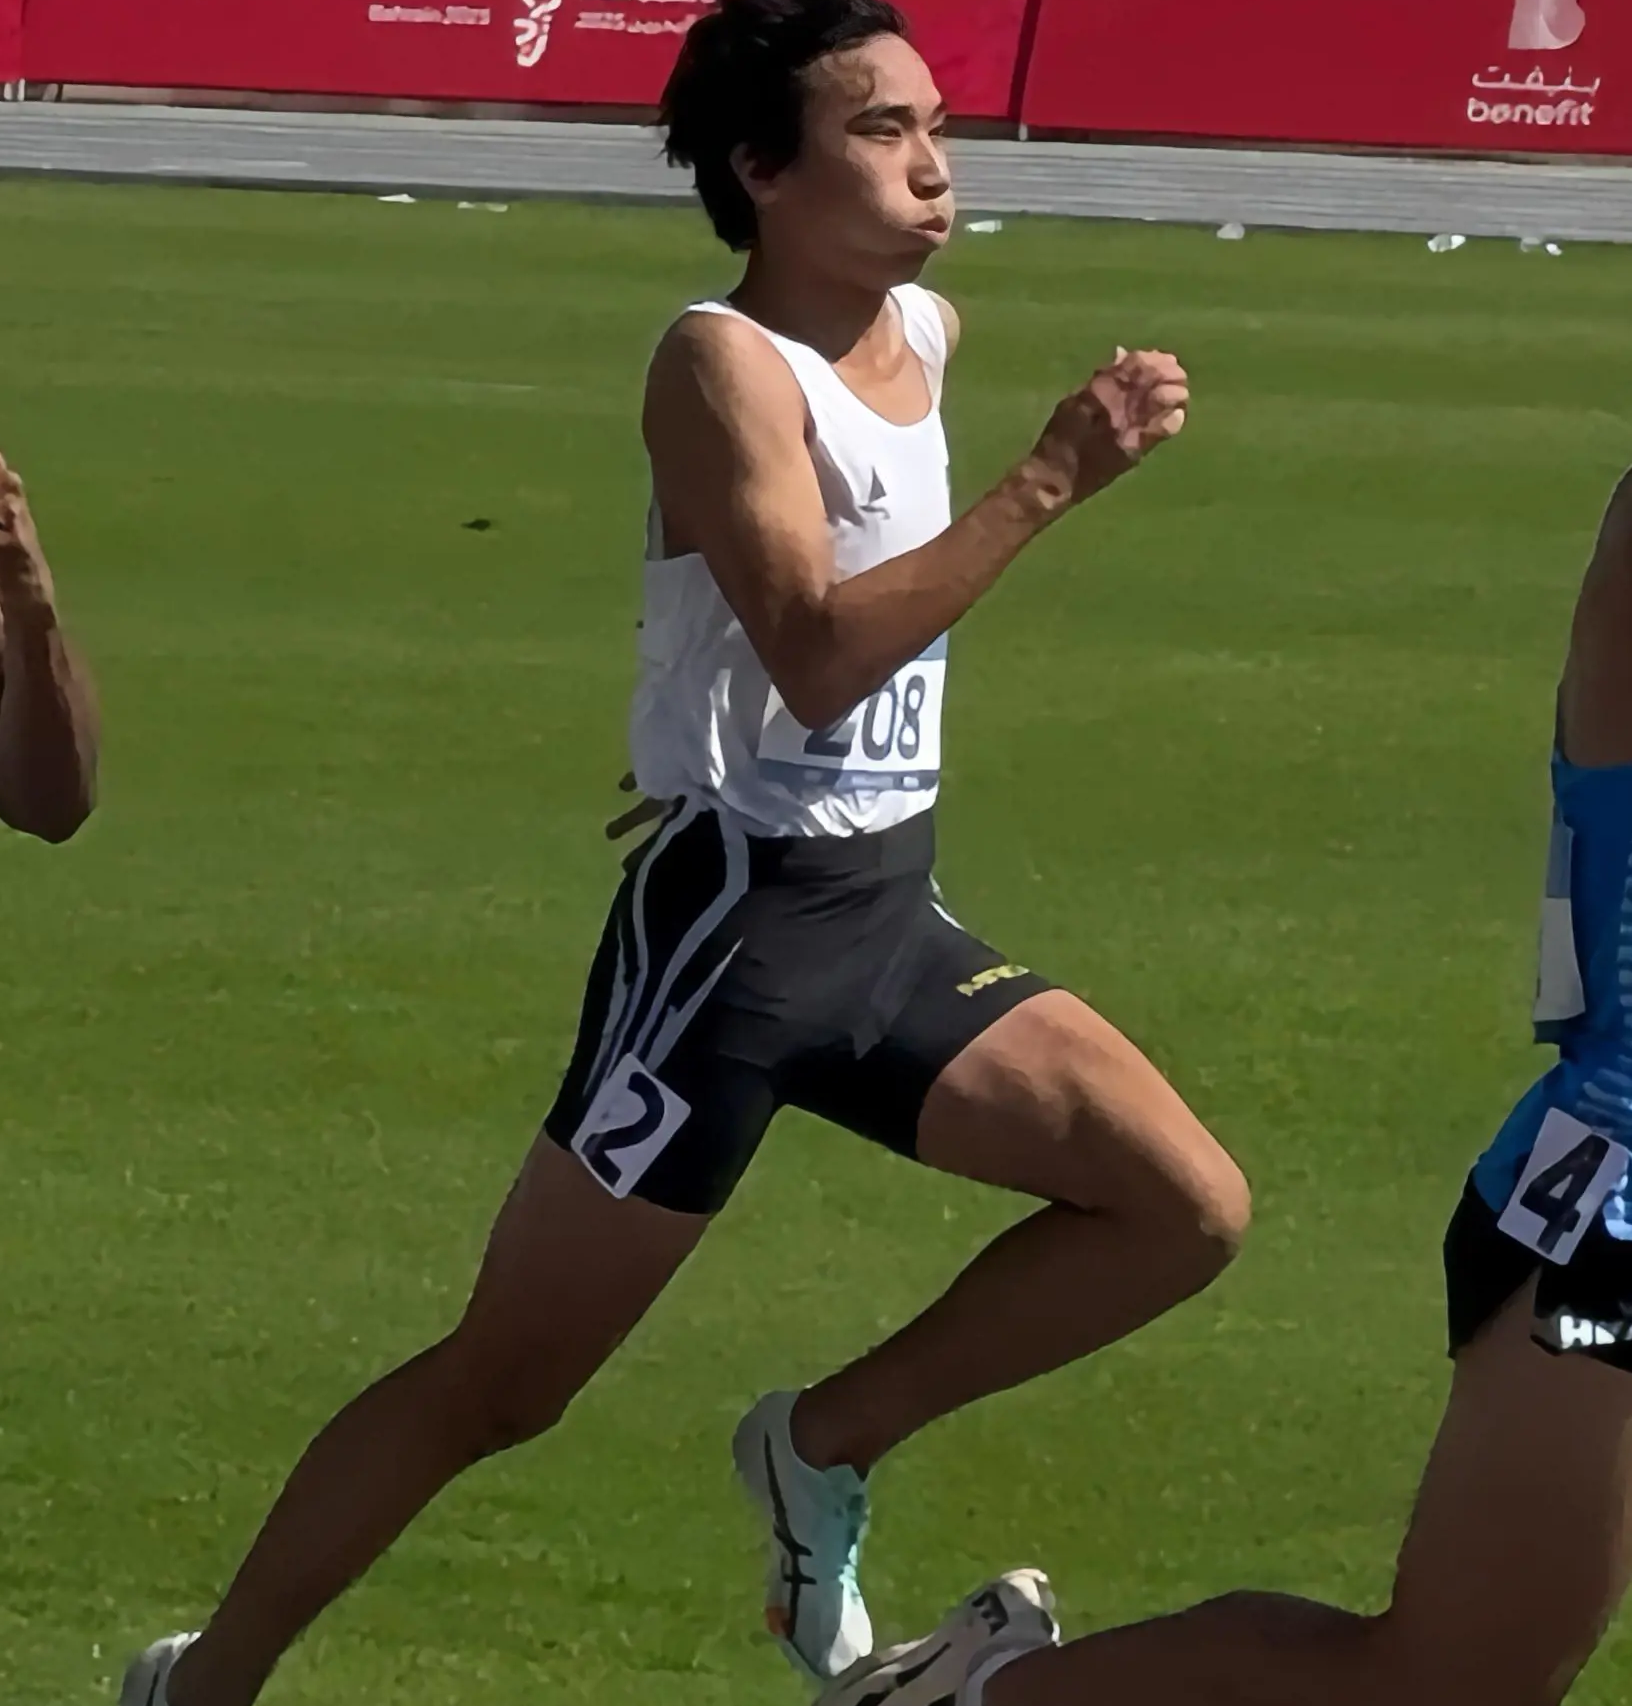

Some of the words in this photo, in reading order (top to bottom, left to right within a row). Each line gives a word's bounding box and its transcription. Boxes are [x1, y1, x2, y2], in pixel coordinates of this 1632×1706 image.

[1467, 97, 1595, 125] benefit
[581, 1071, 665, 1189] 2
[1519, 1134, 1610, 1255] 4
